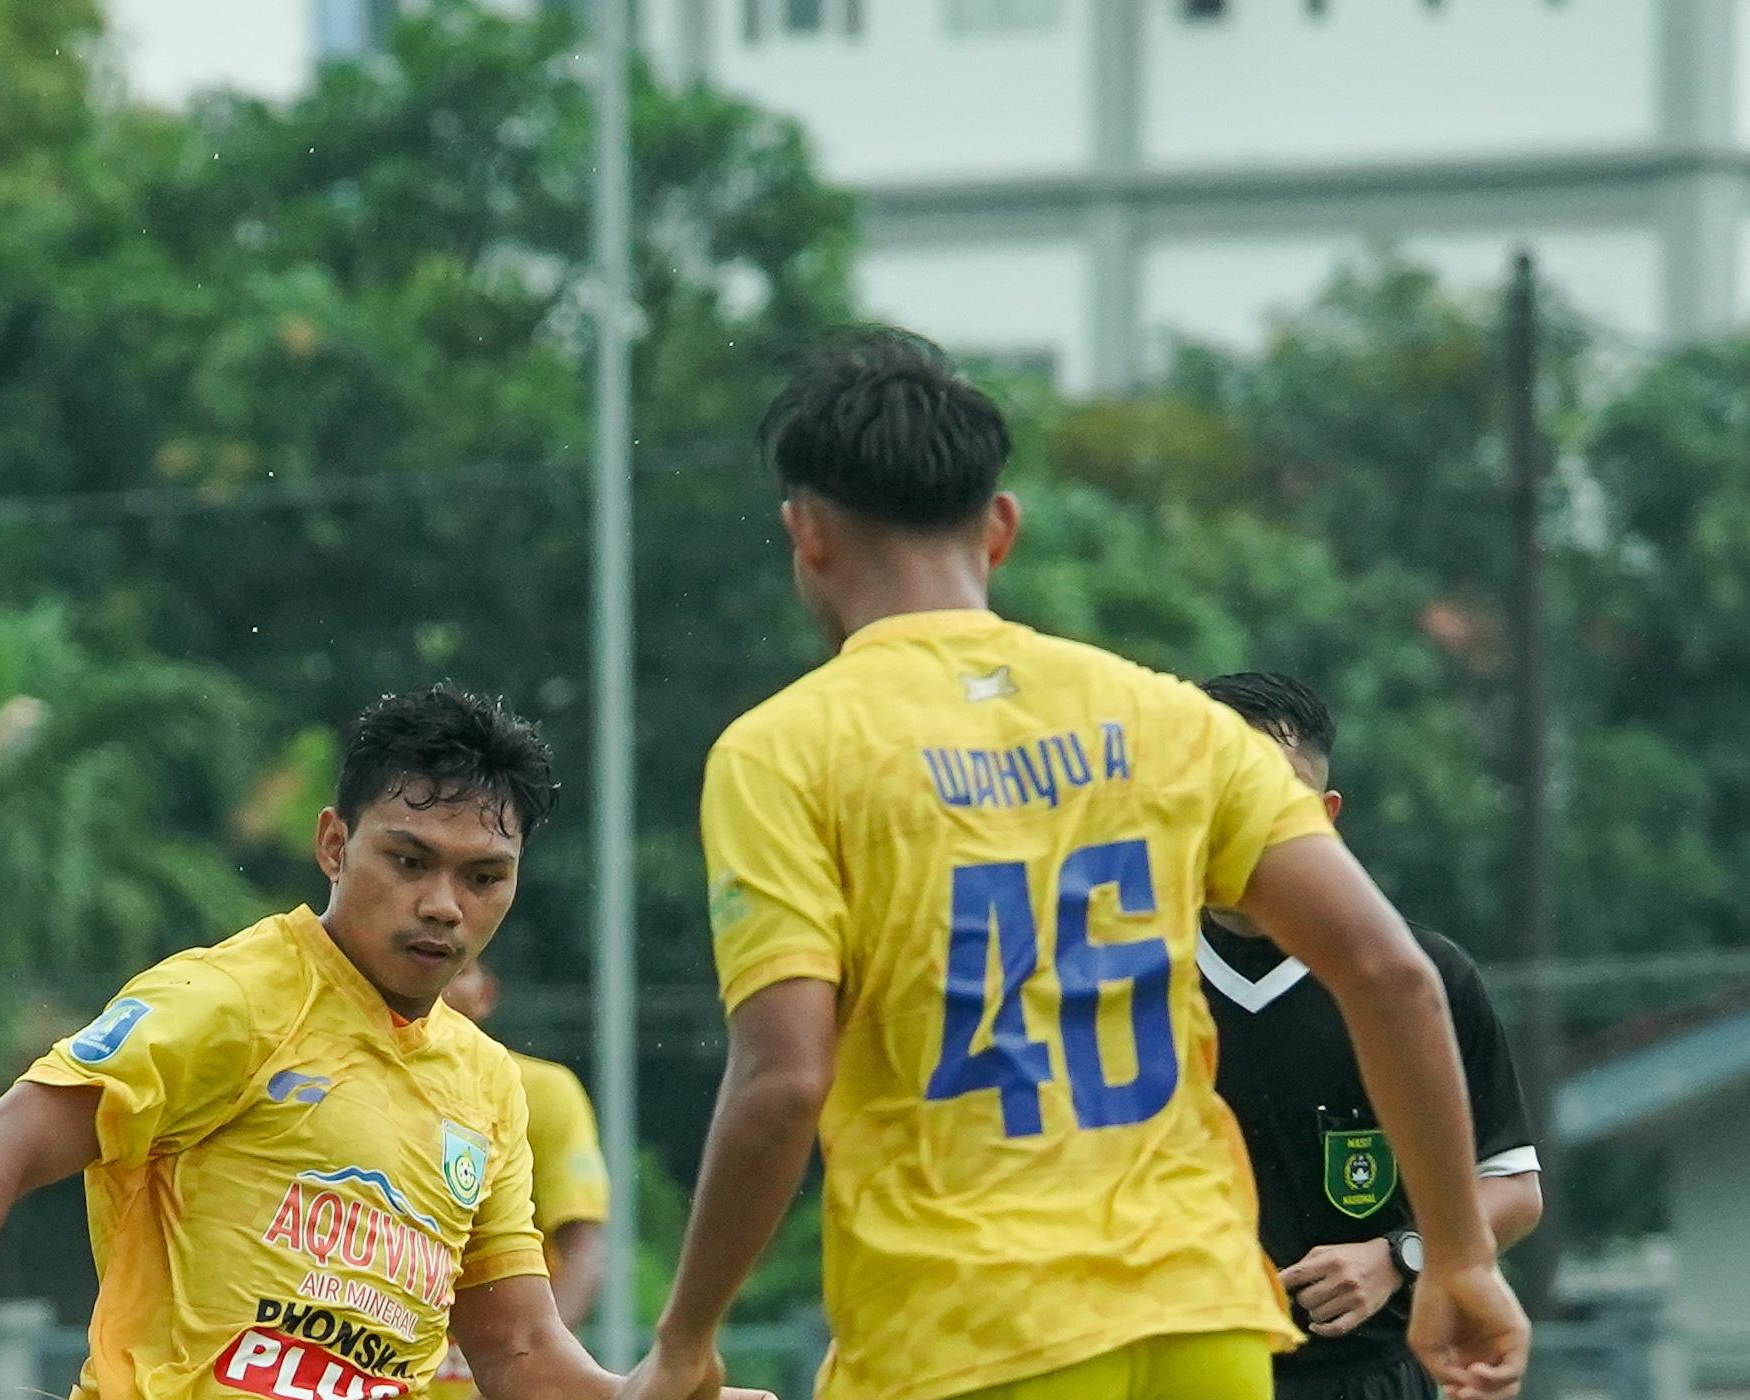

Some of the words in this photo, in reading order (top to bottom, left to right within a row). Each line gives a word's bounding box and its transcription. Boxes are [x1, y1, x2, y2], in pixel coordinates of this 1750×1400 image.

[922, 731, 1093, 809] WAHYU
[1101, 722, 1132, 781] A
[925, 838, 1179, 1139] 46
[298, 1271, 341, 1303] AIR
[345, 1280, 418, 1343] MINERAL
